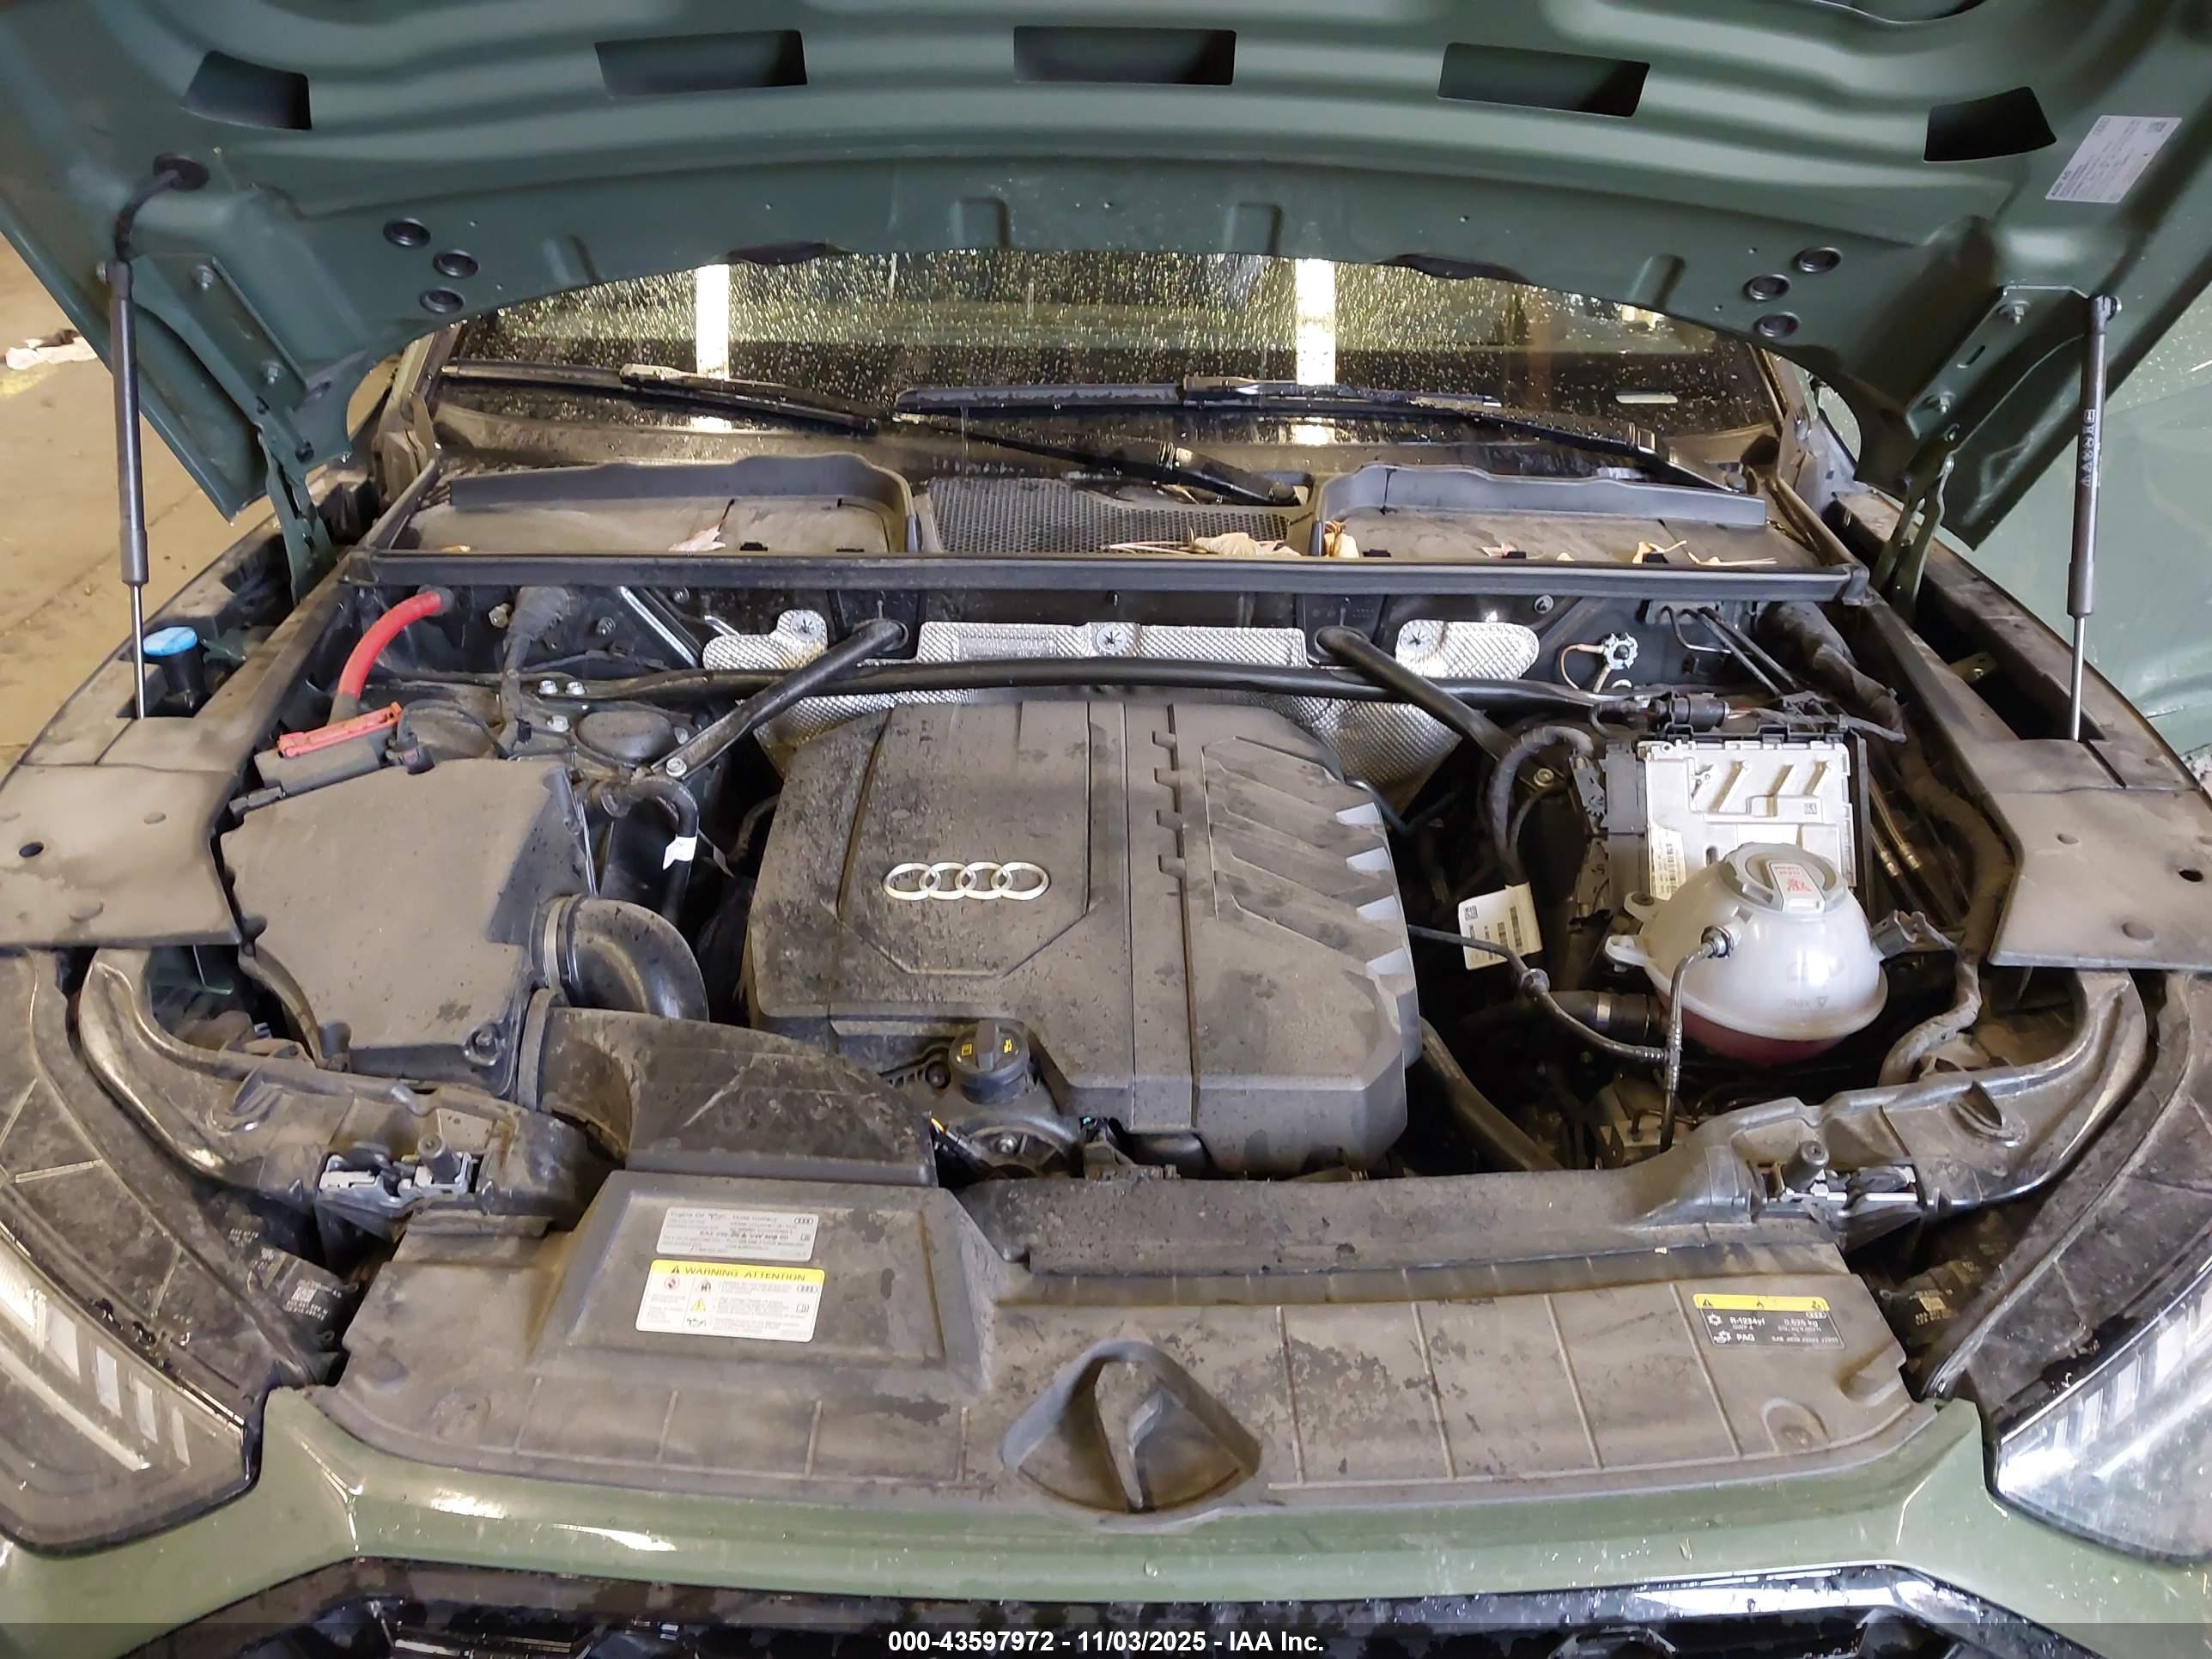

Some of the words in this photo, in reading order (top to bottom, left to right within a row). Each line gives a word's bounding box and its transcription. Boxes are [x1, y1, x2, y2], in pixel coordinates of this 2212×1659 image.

[685, 1267, 738, 1277] WARNING
[744, 1271, 805, 1281] ATTENTION
[1736, 1333, 1756, 1342] PAG
